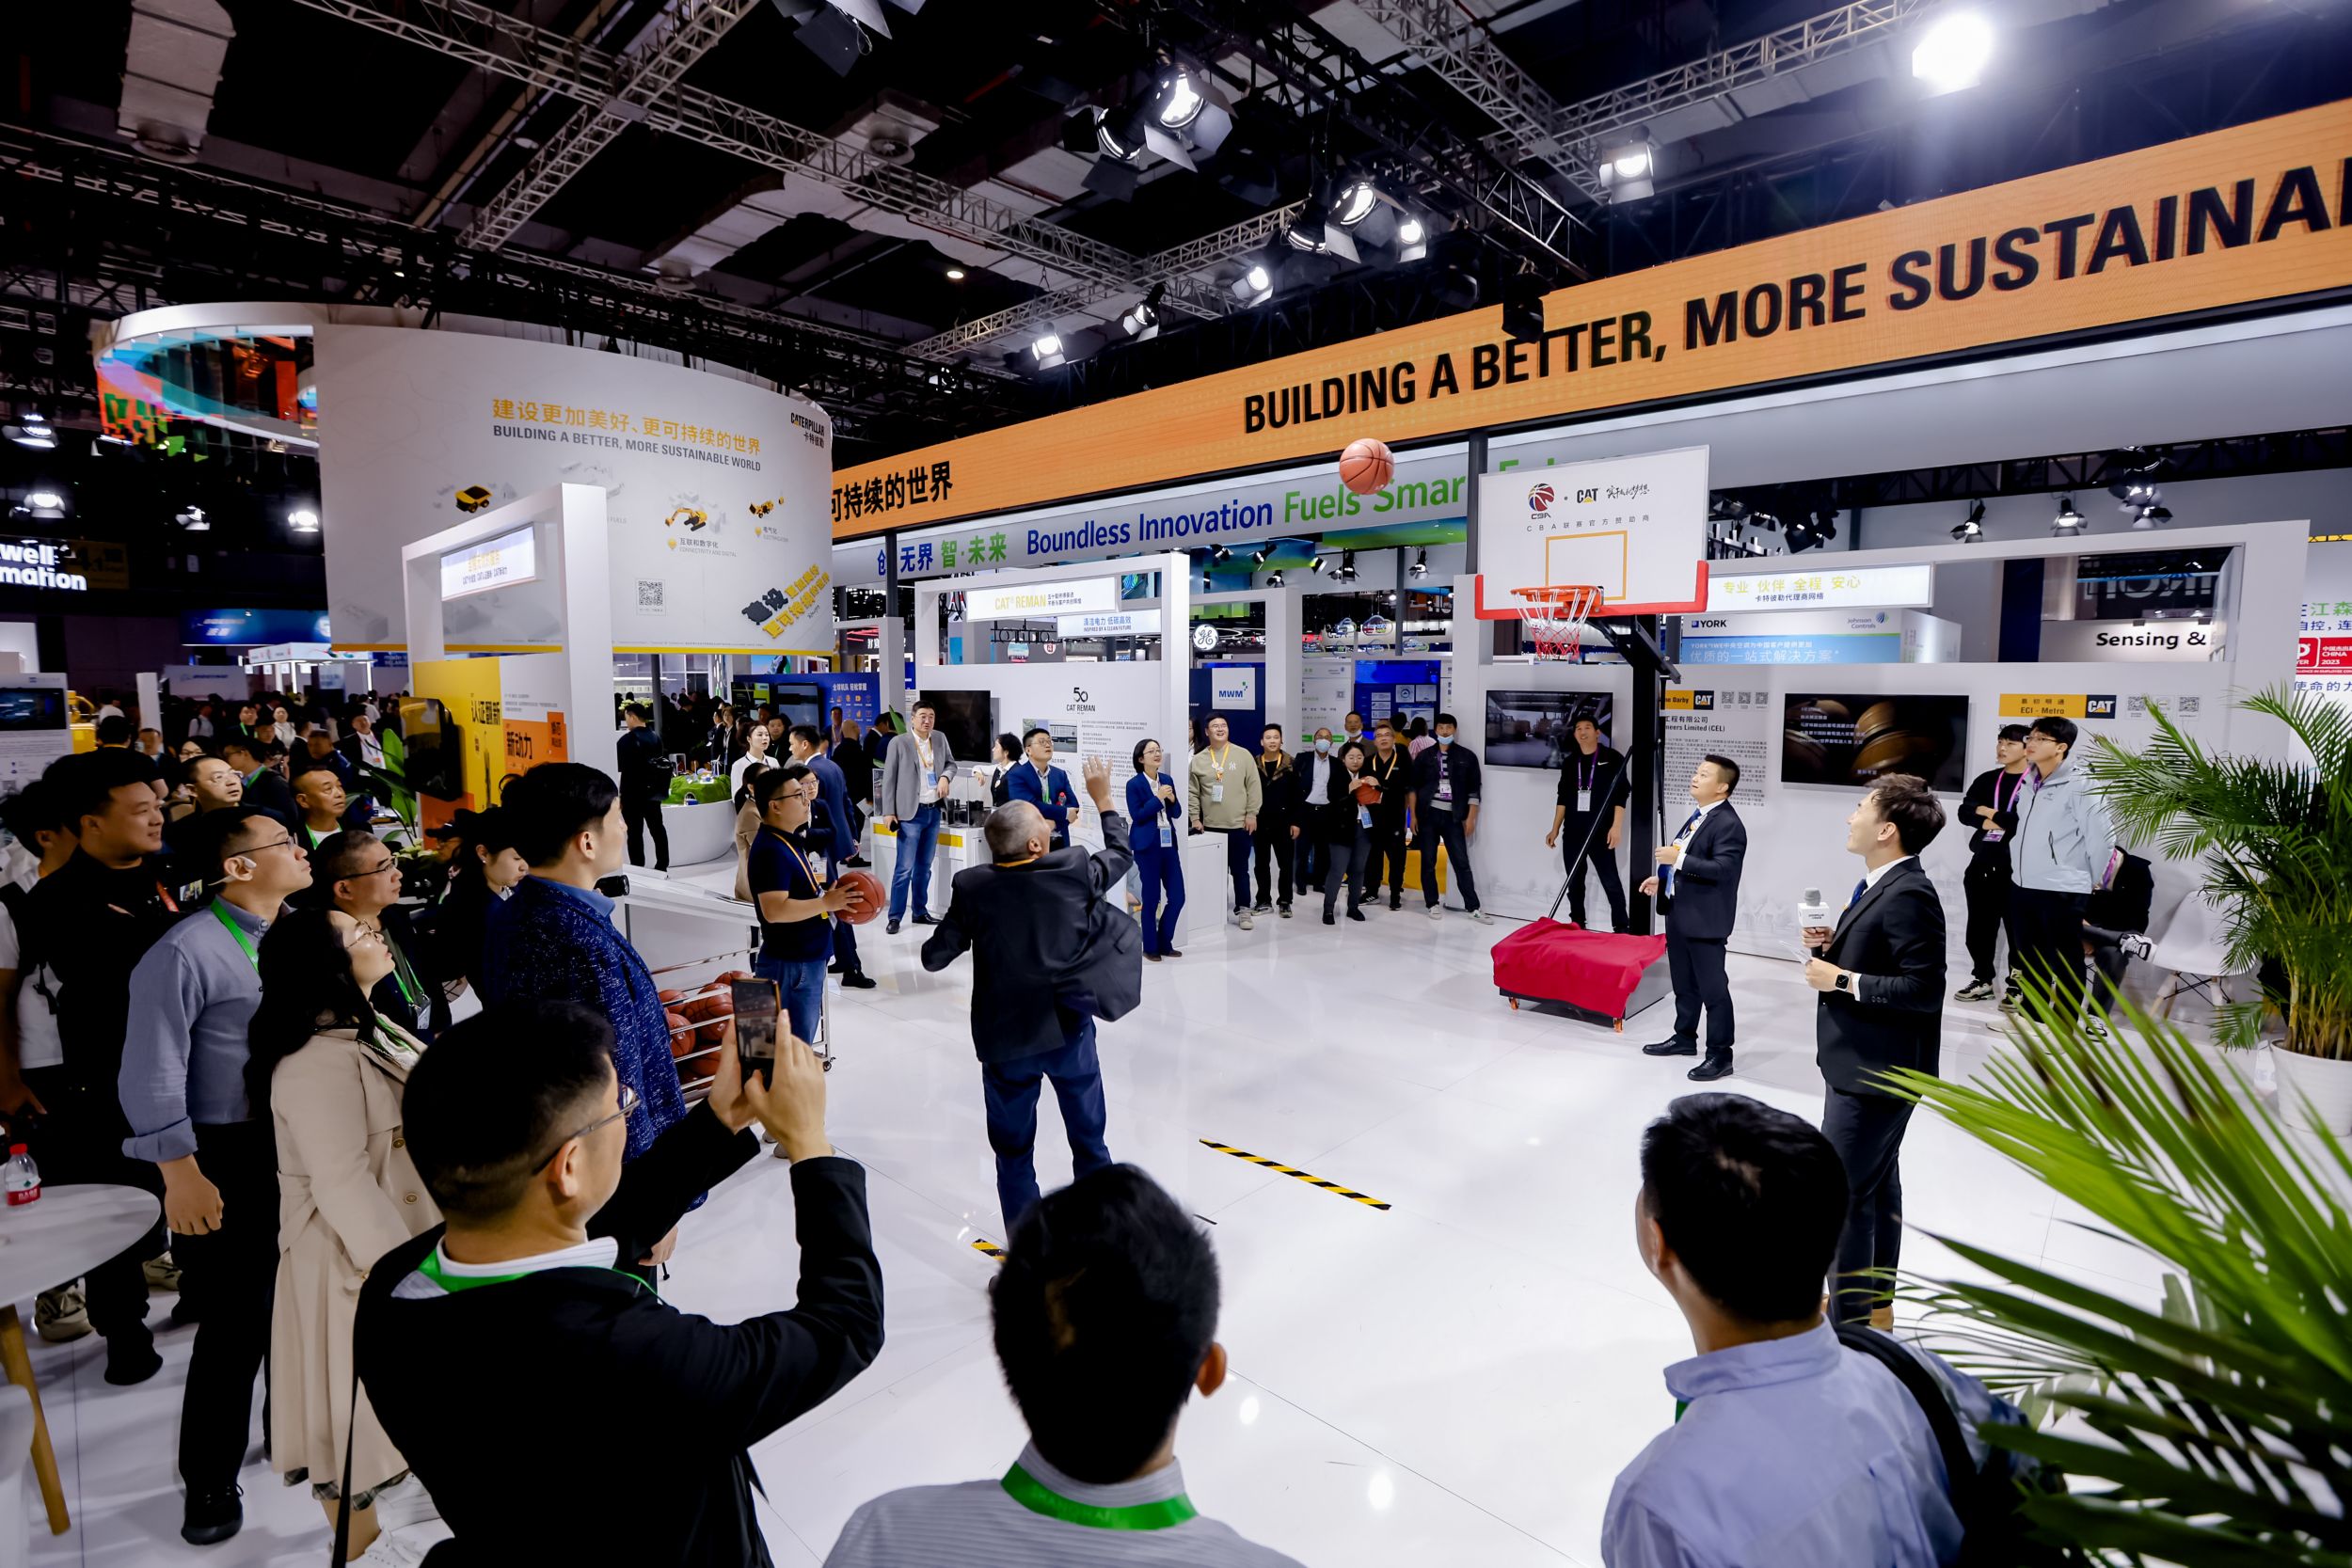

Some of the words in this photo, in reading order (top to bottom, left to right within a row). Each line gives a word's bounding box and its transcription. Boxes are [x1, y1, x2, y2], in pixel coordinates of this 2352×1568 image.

[1245, 361, 1416, 434] BUILDING
[1429, 353, 1459, 399] A
[1471, 310, 1666, 391] BETTER,
[1684, 262, 1867, 350] MORE
[492, 399, 761, 455] 建设更加美好、更可持续的世界
[790, 412, 825, 436] CATERPILLAR
[493, 425, 556, 442] BUILDING
[560, 432, 569, 443] A
[572, 433, 623, 450] BETTER,
[626, 440, 659, 453] MORE
[661, 445, 729, 466] SUSTAINABLE
[731, 456, 761, 471] WORLD
[832, 461, 953, 522] 可持续的世界
[1577, 488, 1598, 503] CAT
[1027, 520, 1130, 555] Boundless
[1139, 499, 1272, 541] Innovation
[1284, 484, 1360, 523] Fuels
[1373, 476, 1466, 512] Smar
[680, 538, 719, 548] 互联和数字化
[0, 544, 55, 566] well
[0, 565, 87, 591] mation
[1724, 580, 1748, 594] 专业
[1757, 578, 1785, 593] 伙伴
[1793, 578, 1822, 592] 全程
[1832, 576, 1861, 590] 安心
[1015, 594, 1046, 608] REMAN
[1756, 593, 1823, 602] 卡特彼勒代理商网络
[1700, 619, 1726, 627] YORK
[1195, 627, 1216, 647] GE
[2096, 632, 2179, 649] Sensing
[2187, 631, 2206, 646] &
[1073, 687, 1089, 702] 50
[1695, 695, 1712, 705] CAT
[2088, 700, 2114, 712] CAT
